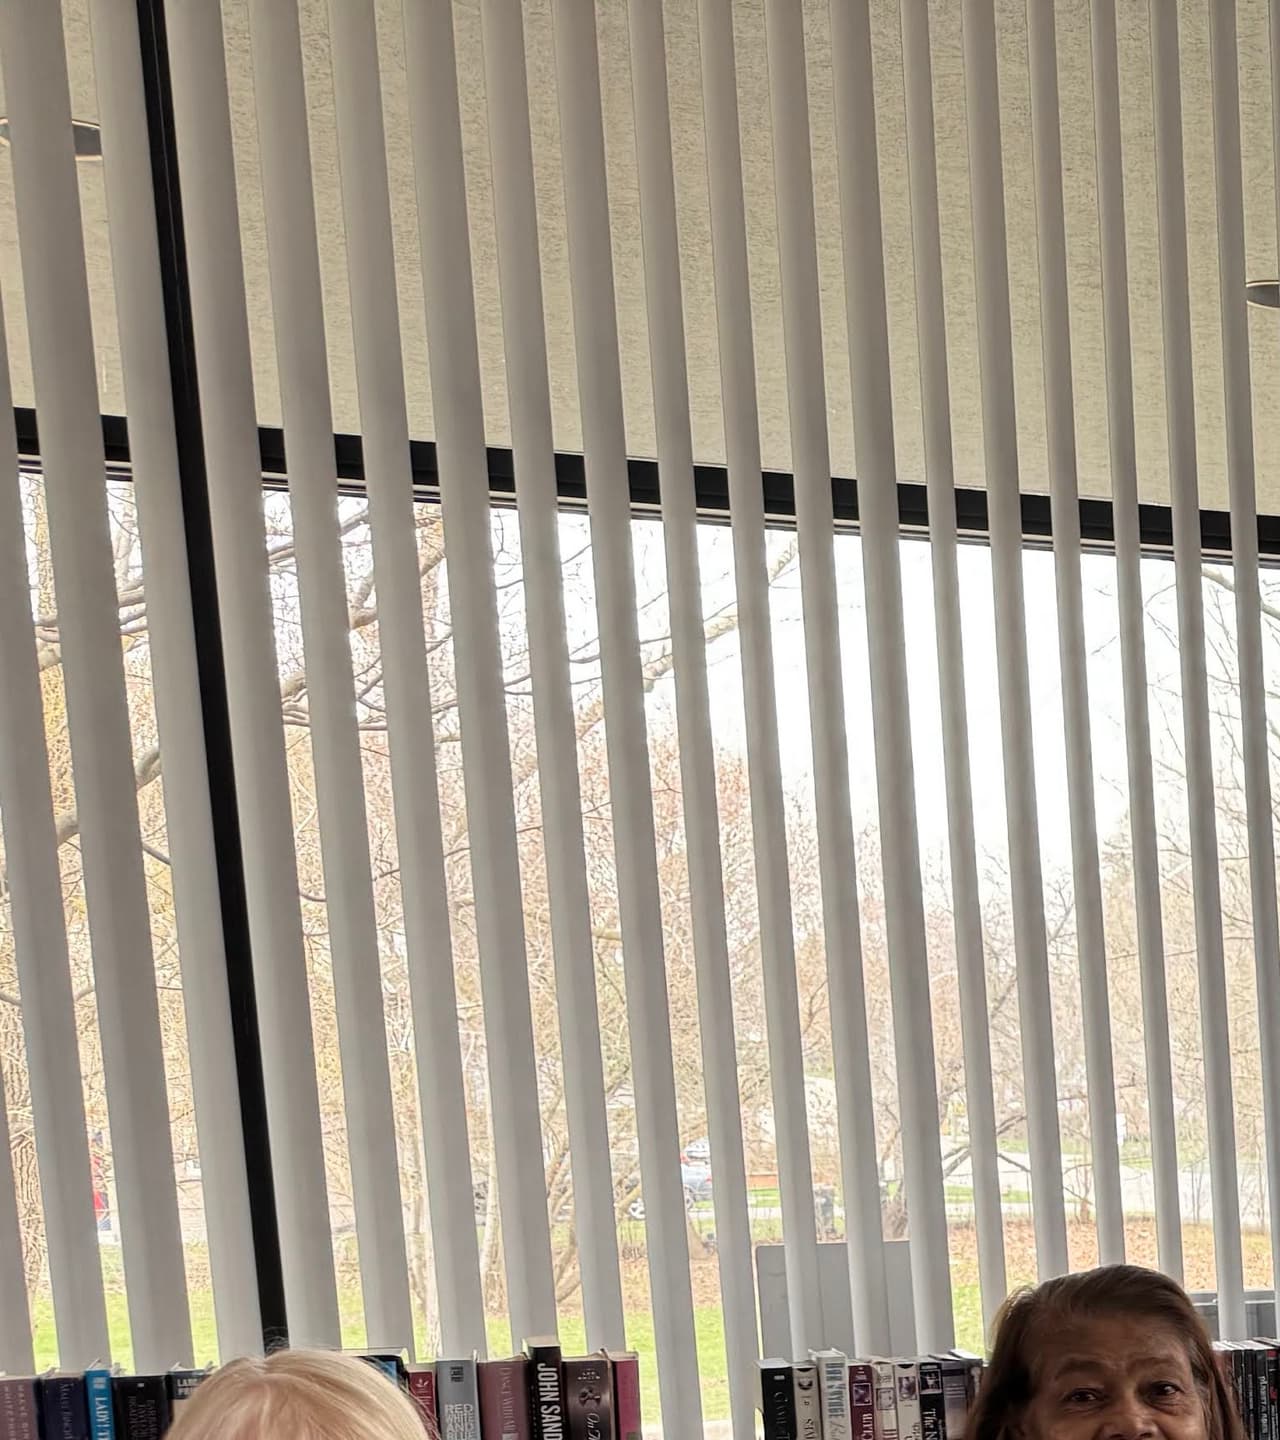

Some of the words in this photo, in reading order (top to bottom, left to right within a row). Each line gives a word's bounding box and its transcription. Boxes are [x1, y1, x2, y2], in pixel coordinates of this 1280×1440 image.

[536, 1362, 559, 1403] JOHN
[94, 1397, 109, 1428] LADY!
[922, 1408, 937, 1429] The
